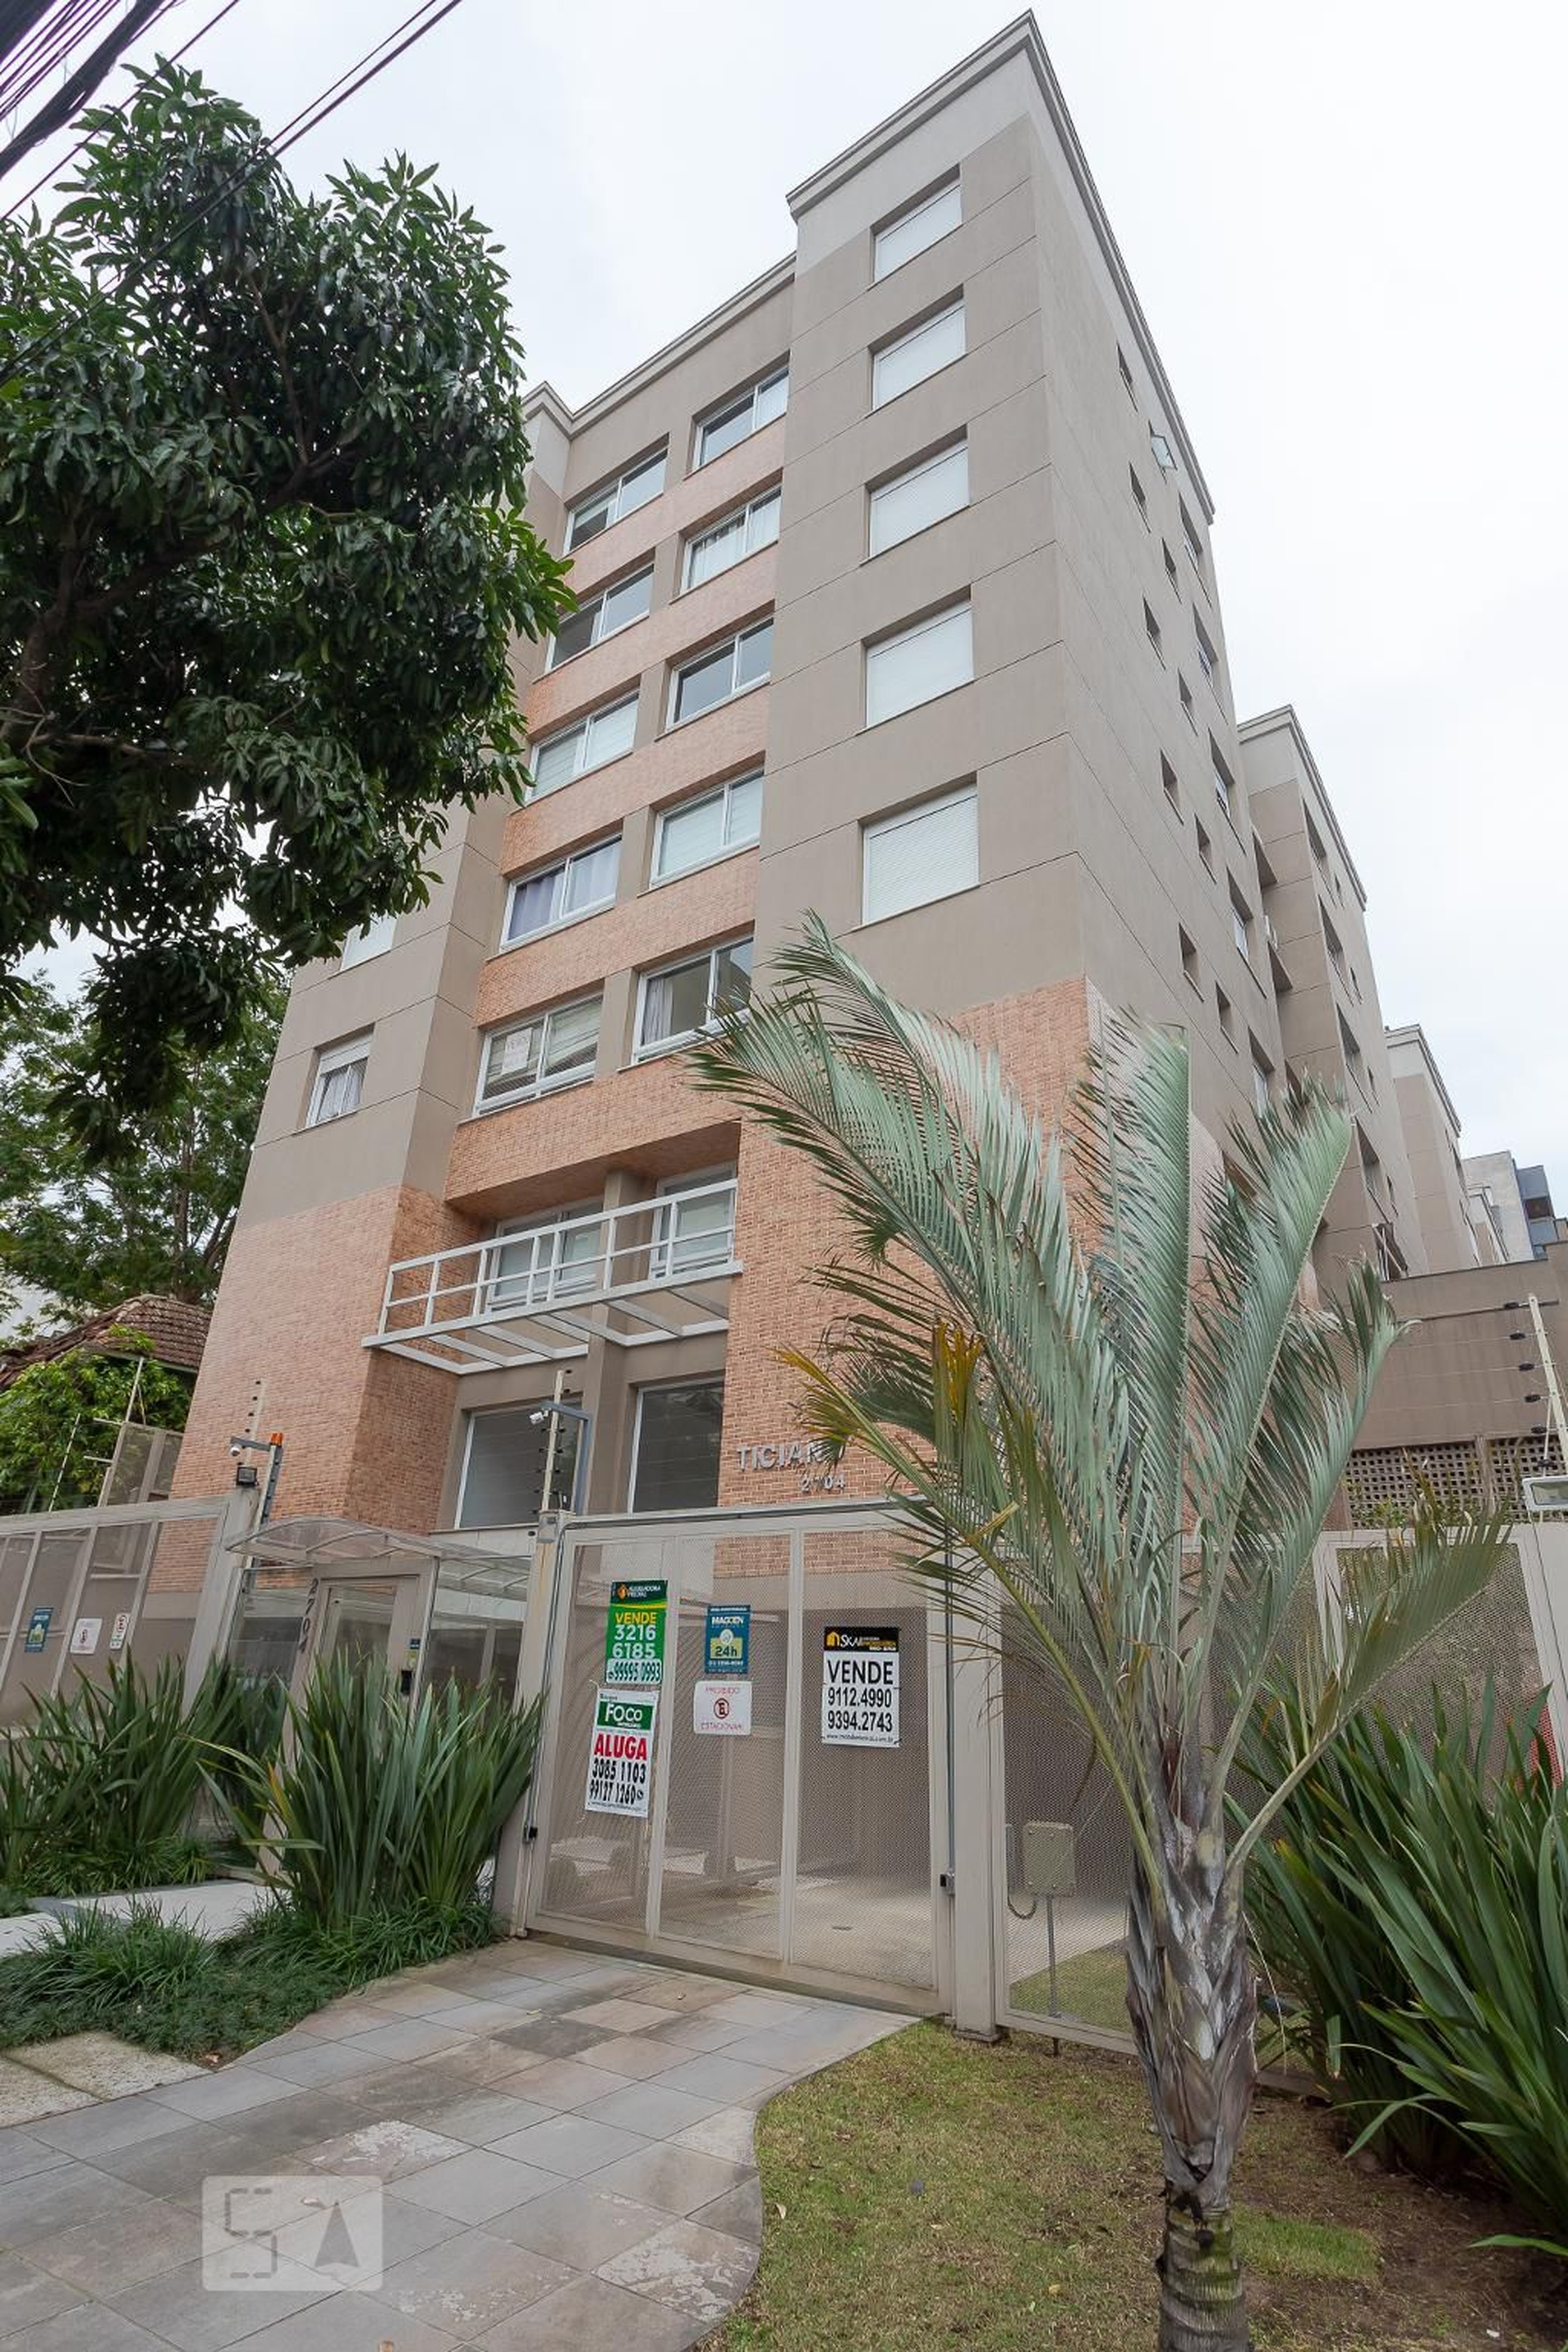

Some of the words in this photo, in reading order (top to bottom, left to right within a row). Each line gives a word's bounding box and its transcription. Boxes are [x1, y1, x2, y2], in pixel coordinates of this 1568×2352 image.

[737, 1441, 845, 1470] TICIA
[801, 1473, 846, 1494] 204
[615, 1612, 657, 1624] VENDE
[614, 1624, 656, 1641] 3216
[612, 1642, 656, 1659] 6185
[715, 1646, 737, 1657] 24h
[828, 1659, 893, 1685] VENDE
[828, 1687, 892, 1708] 9112.4990
[828, 1710, 893, 1732] 9394.2743
[594, 1733, 647, 1761] ALUGA
[592, 1757, 616, 1780] 3085
[621, 1761, 646, 1784] 1103
[615, 1782, 636, 1805] 1260
